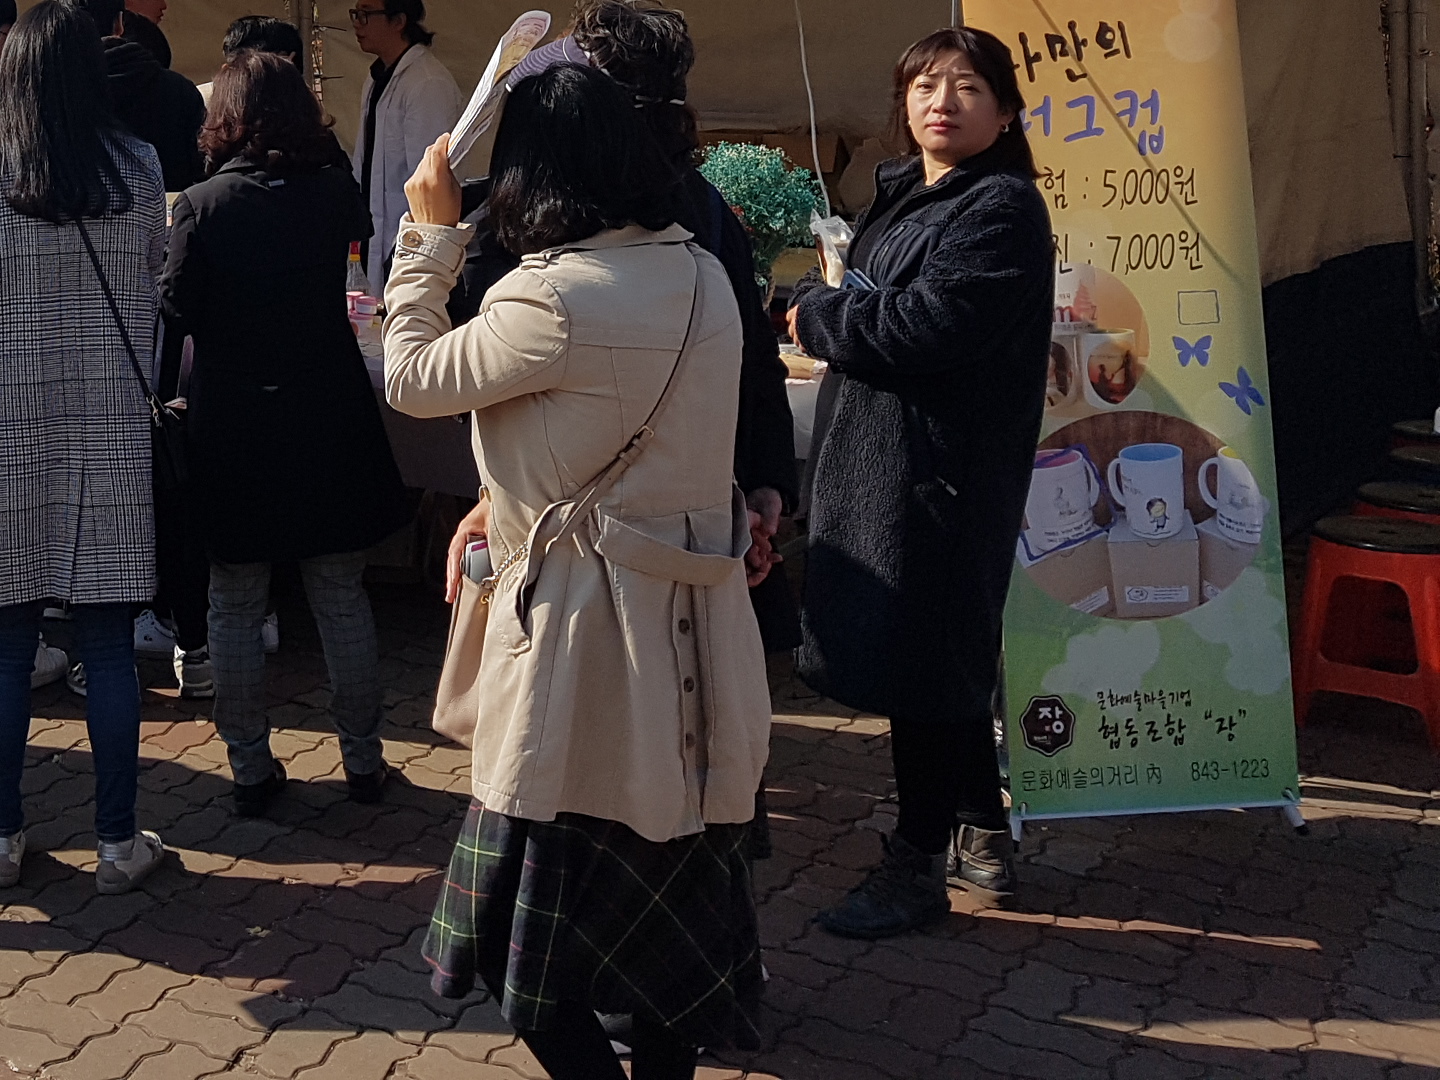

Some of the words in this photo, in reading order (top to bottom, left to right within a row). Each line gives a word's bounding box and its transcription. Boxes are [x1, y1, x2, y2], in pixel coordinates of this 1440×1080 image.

[1043, 166, 1069, 210] 험
[1101, 164, 1199, 211] 5,000원
[1106, 230, 1204, 276] 7,000원
[1037, 706, 1064, 735] 장
[1098, 713, 1187, 750] 협동조합
[1191, 757, 1270, 781] 843-1223
